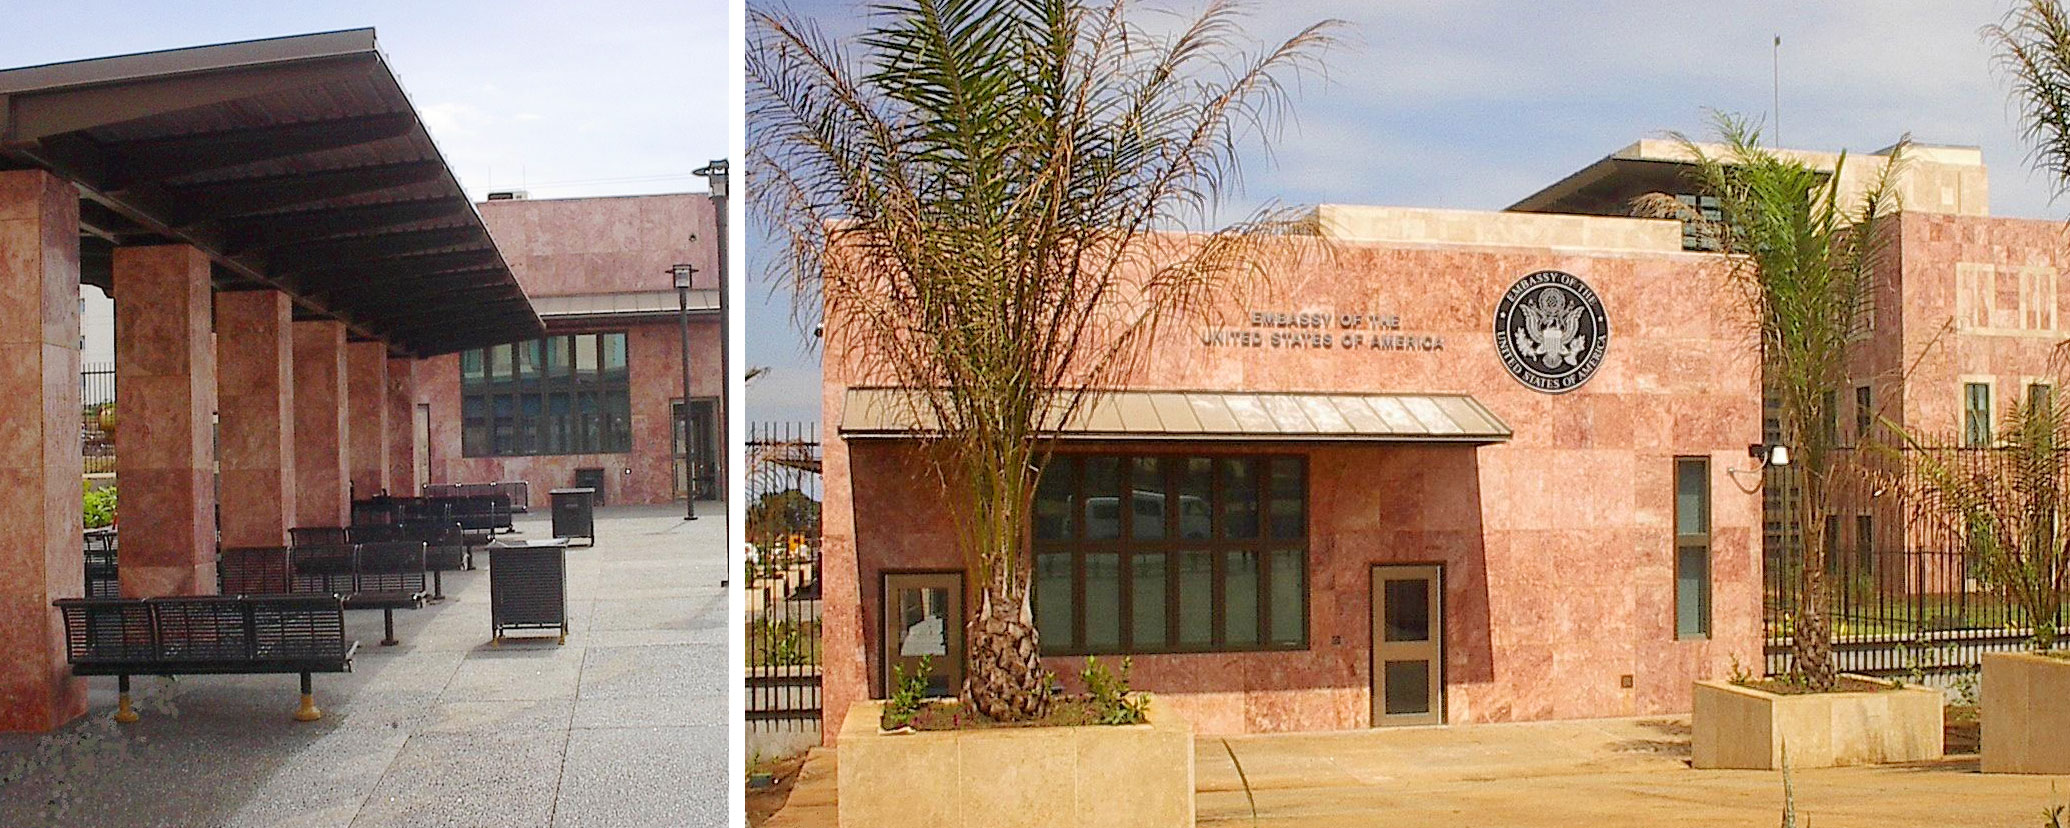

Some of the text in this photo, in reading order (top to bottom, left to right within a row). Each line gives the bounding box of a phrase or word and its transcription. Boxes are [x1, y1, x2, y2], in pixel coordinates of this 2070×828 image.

[1506, 272, 1598, 305] EMBASSY OF THE
[1251, 311, 1400, 331] EMBASSY OF THE
[1202, 330, 1444, 351] UNITED STATES OF AMERICA
[1497, 331, 1607, 388] UNITED STATES OF AMERICA
